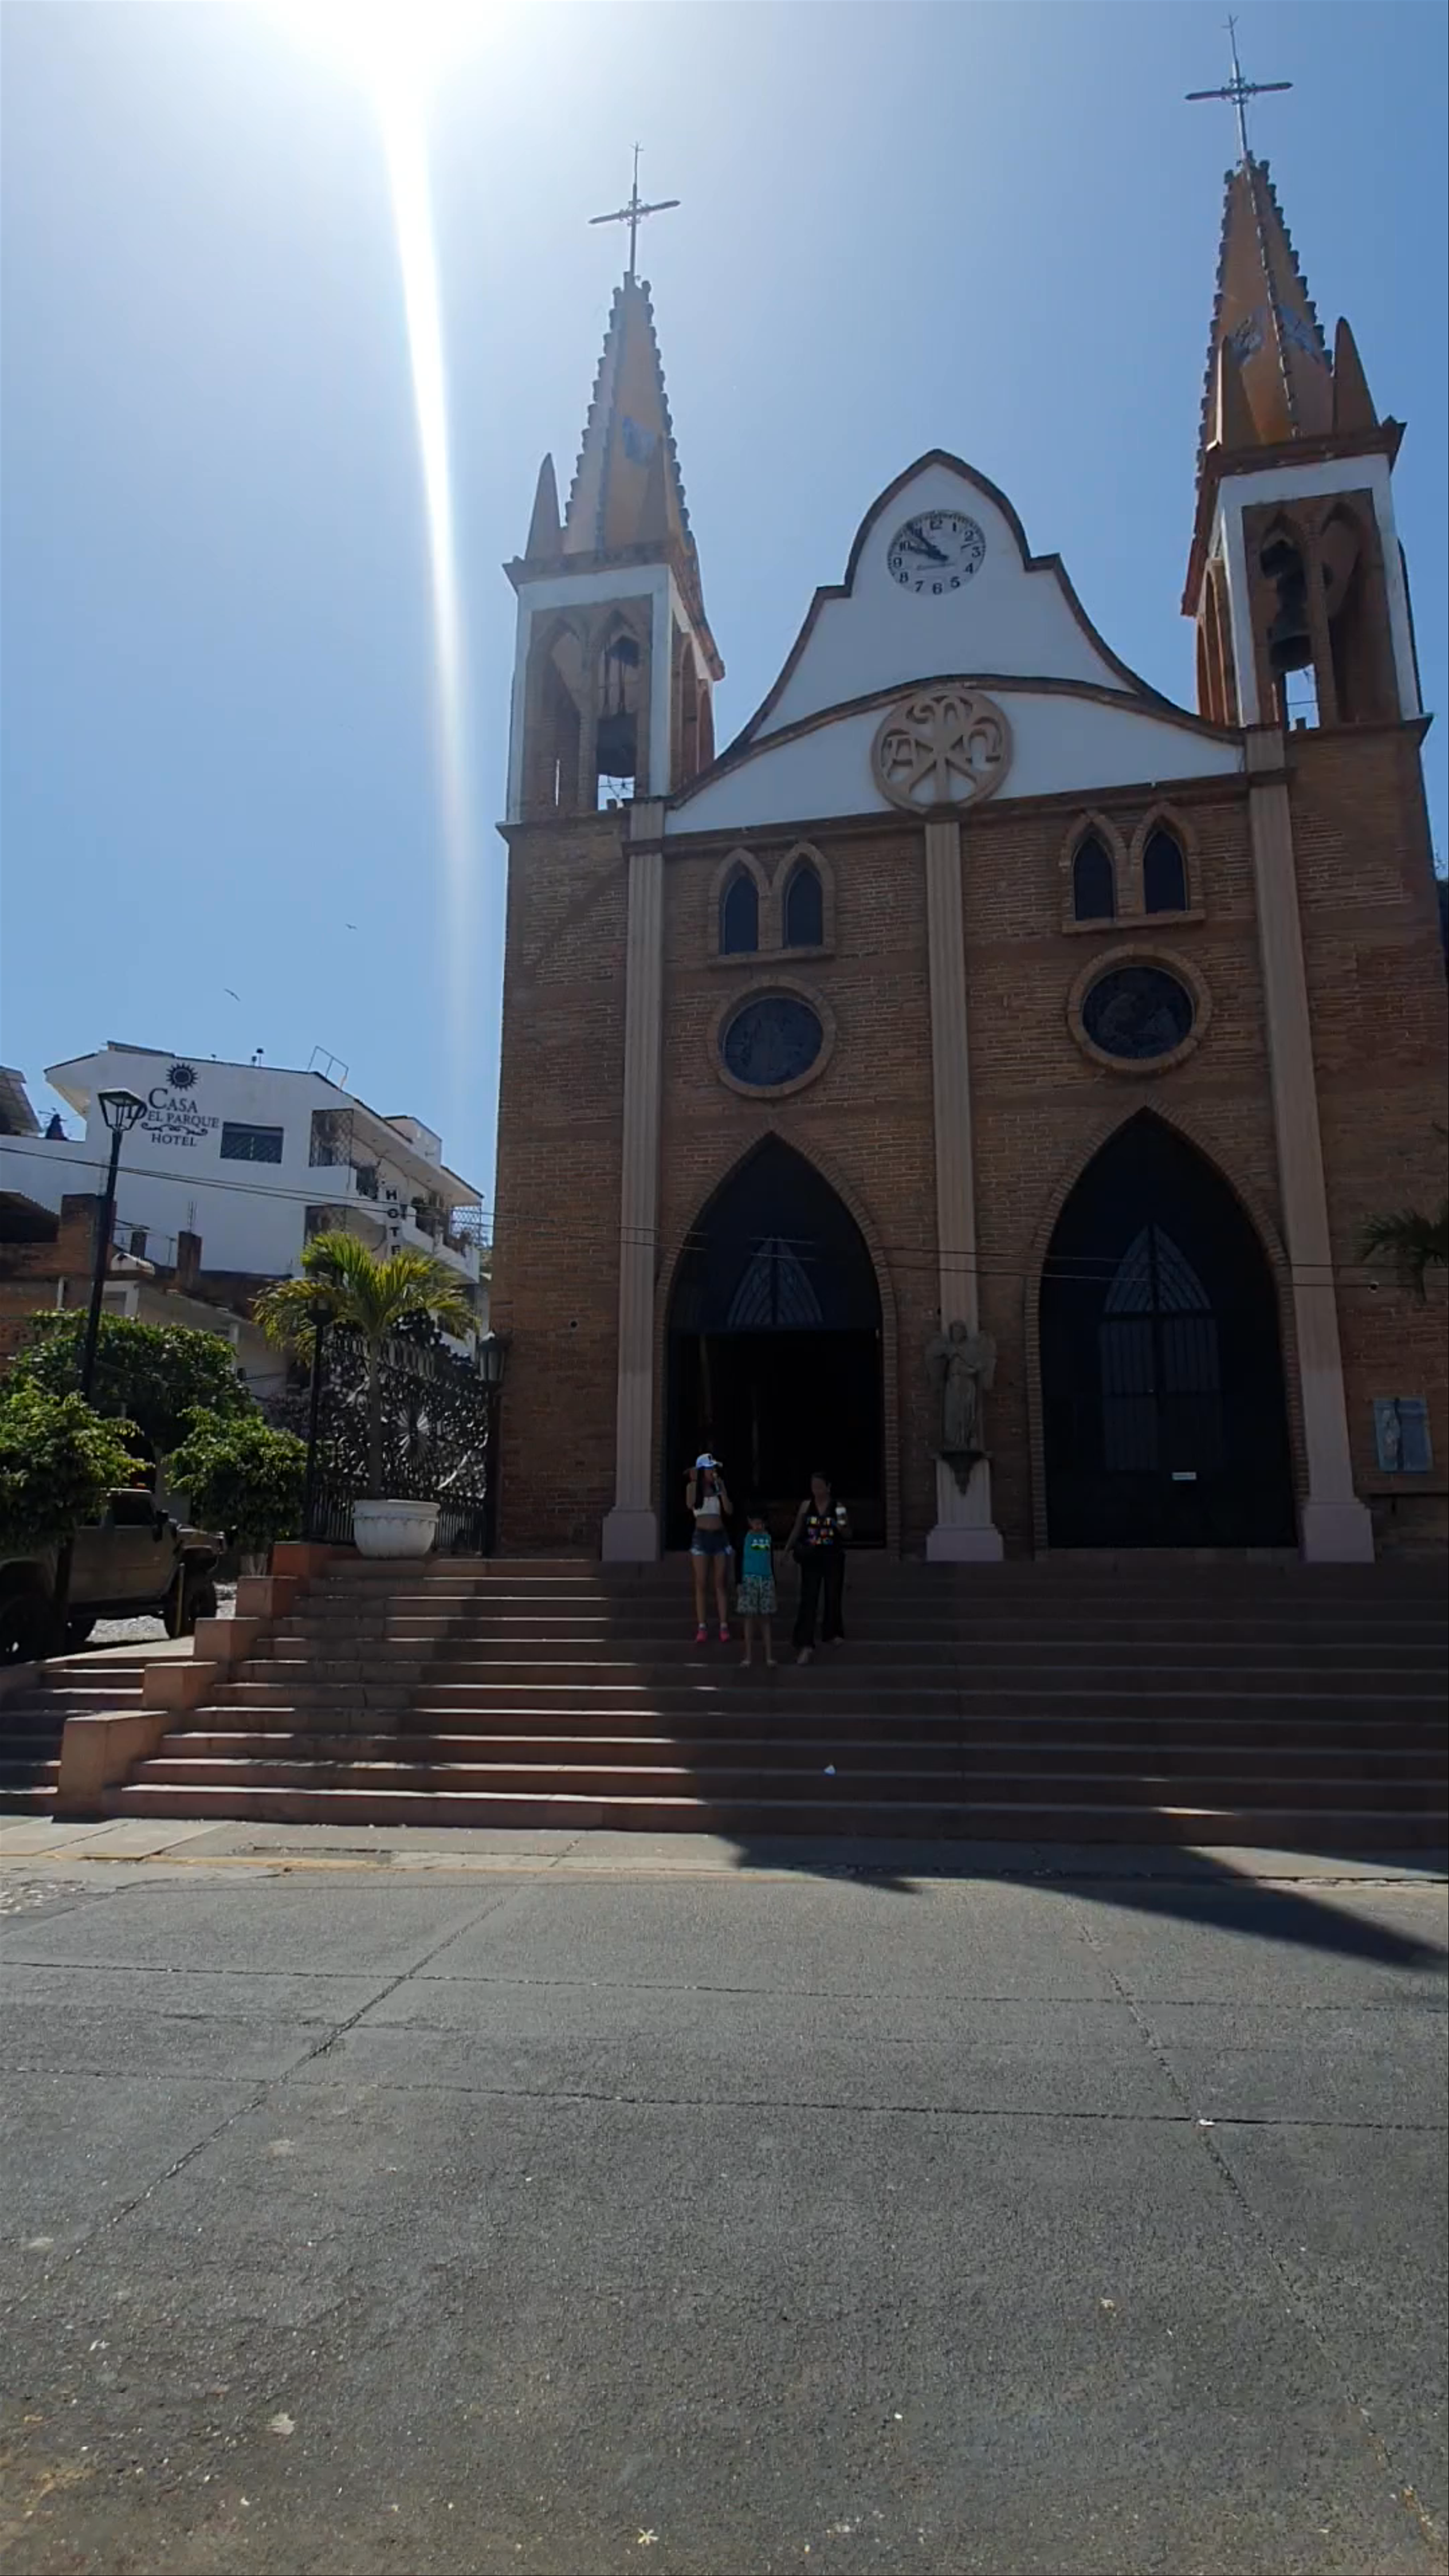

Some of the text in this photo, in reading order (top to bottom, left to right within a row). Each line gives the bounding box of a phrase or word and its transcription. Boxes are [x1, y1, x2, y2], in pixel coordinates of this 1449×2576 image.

[953, 522, 956, 532] 1
[964, 530, 974, 542] 2
[899, 541, 911, 551] 10
[972, 547, 981, 558] 3
[893, 557, 902, 568] 9
[965, 563, 973, 574] 4
[899, 572, 909, 583] 8
[949, 577, 960, 588] 5
[915, 580, 924, 592] 7
[932, 583, 943, 595] 6
[167, 1112, 220, 1128] PARQUE
[152, 1133, 197, 1147] HOTEL
